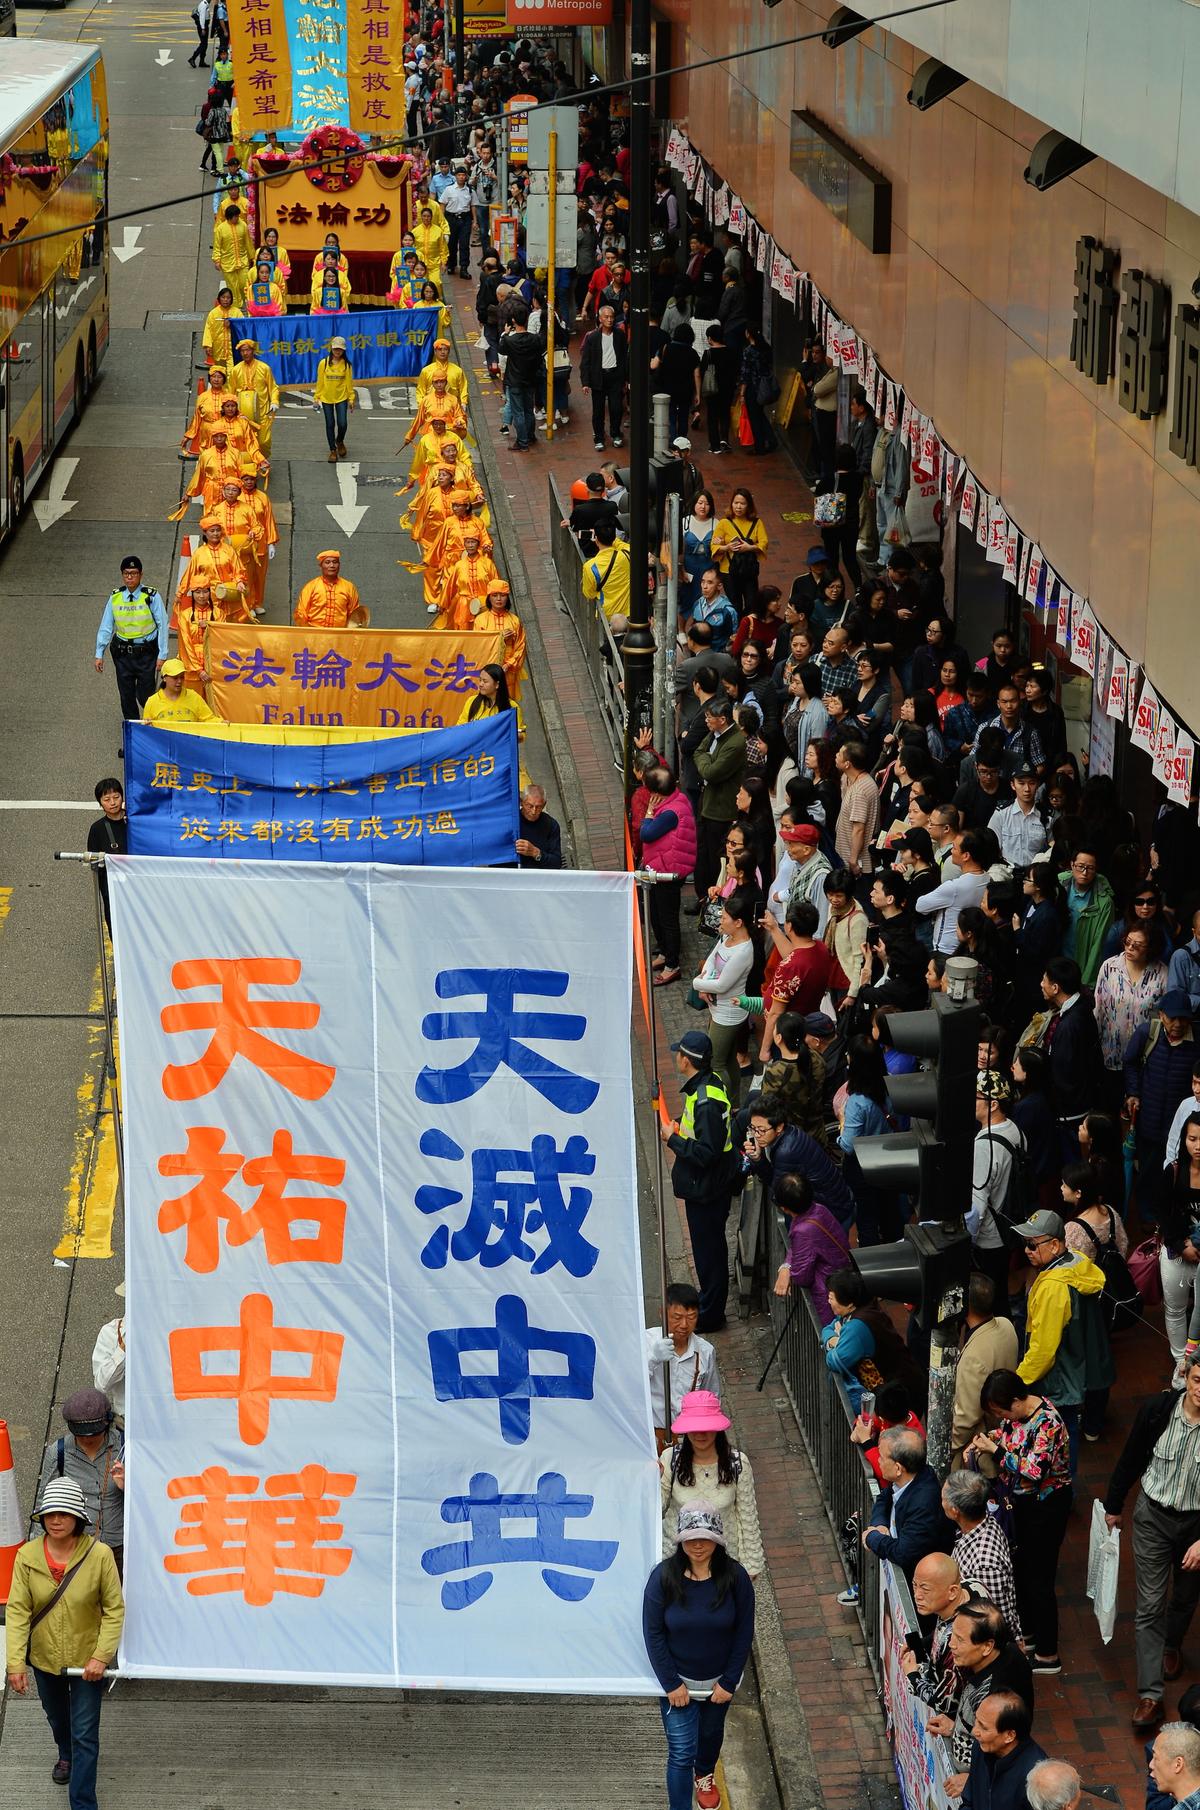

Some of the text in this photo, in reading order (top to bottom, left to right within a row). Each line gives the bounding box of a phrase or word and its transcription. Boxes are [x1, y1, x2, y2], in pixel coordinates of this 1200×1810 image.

[547, 0, 602, 10] Metropole
[276, 202, 391, 226] 法輪功
[222, 647, 481, 693] 法輪大法
[262, 704, 344, 726] Falun
[379, 708, 444, 727] Dafa
[157, 958, 358, 1606] 天祐中華
[414, 968, 620, 1611] 天滅中共
